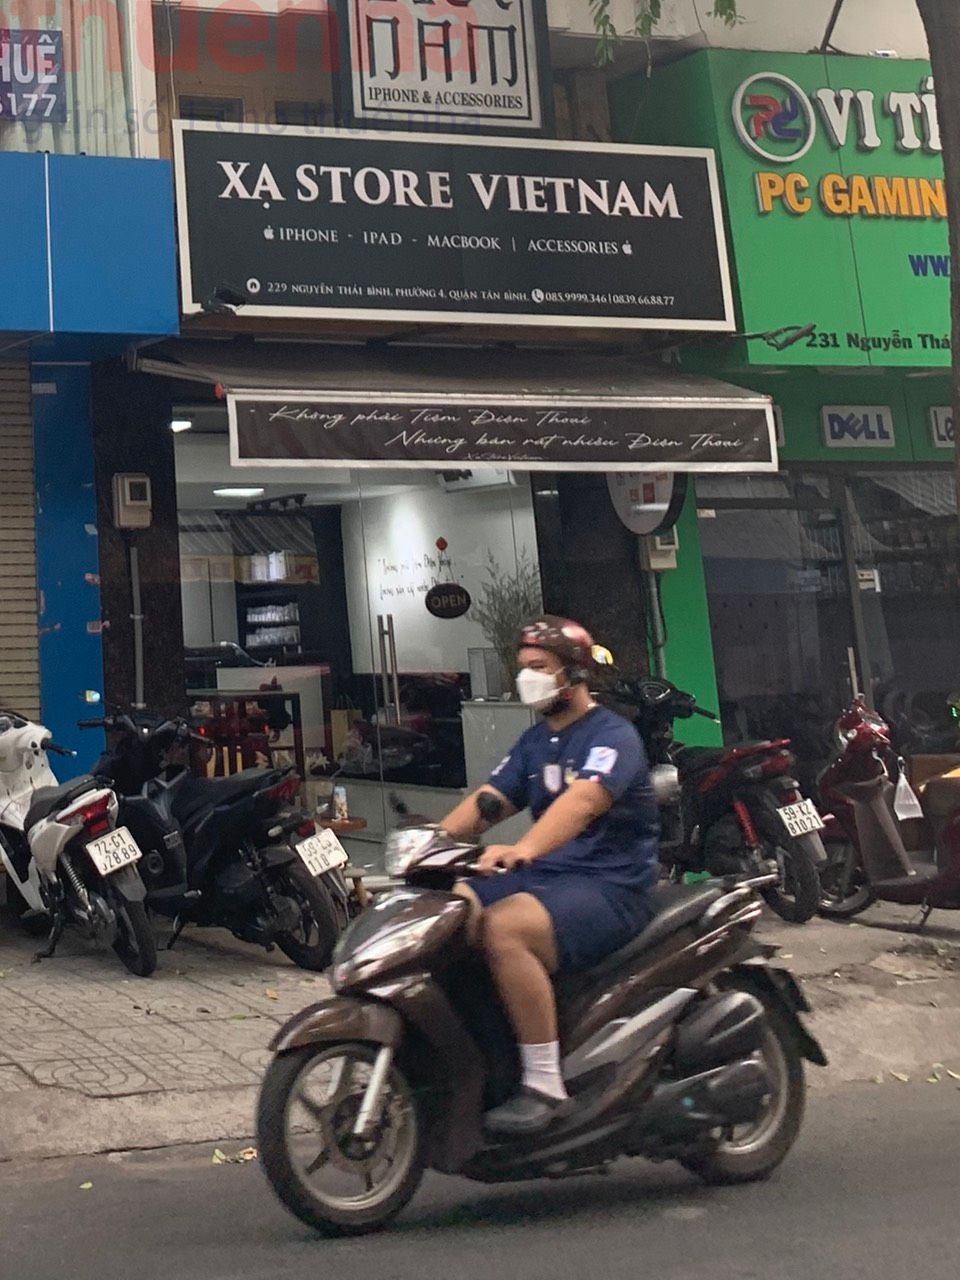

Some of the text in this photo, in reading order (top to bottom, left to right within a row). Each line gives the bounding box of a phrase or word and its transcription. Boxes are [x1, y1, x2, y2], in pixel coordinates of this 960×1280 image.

[368, 86, 523, 110] IPHONE & ACCESSORIES
[813, 87, 881, 151] VI
[216, 160, 683, 220] XẠ STORE VIETNAM
[754, 171, 948, 218] PC GAMIN
[278, 227, 339, 244] IPHONE
[362, 230, 403, 247] IPAD
[426, 233, 501, 251] MACBOOK
[527, 238, 618, 255] ACCESSORIES
[908, 254, 951, 277] WW
[267, 281, 288, 293] 229
[806, 329, 951, 351] 231 Nguyễn Thá
[827, 412, 890, 442] DELL
[431, 593, 466, 609] OPEN
